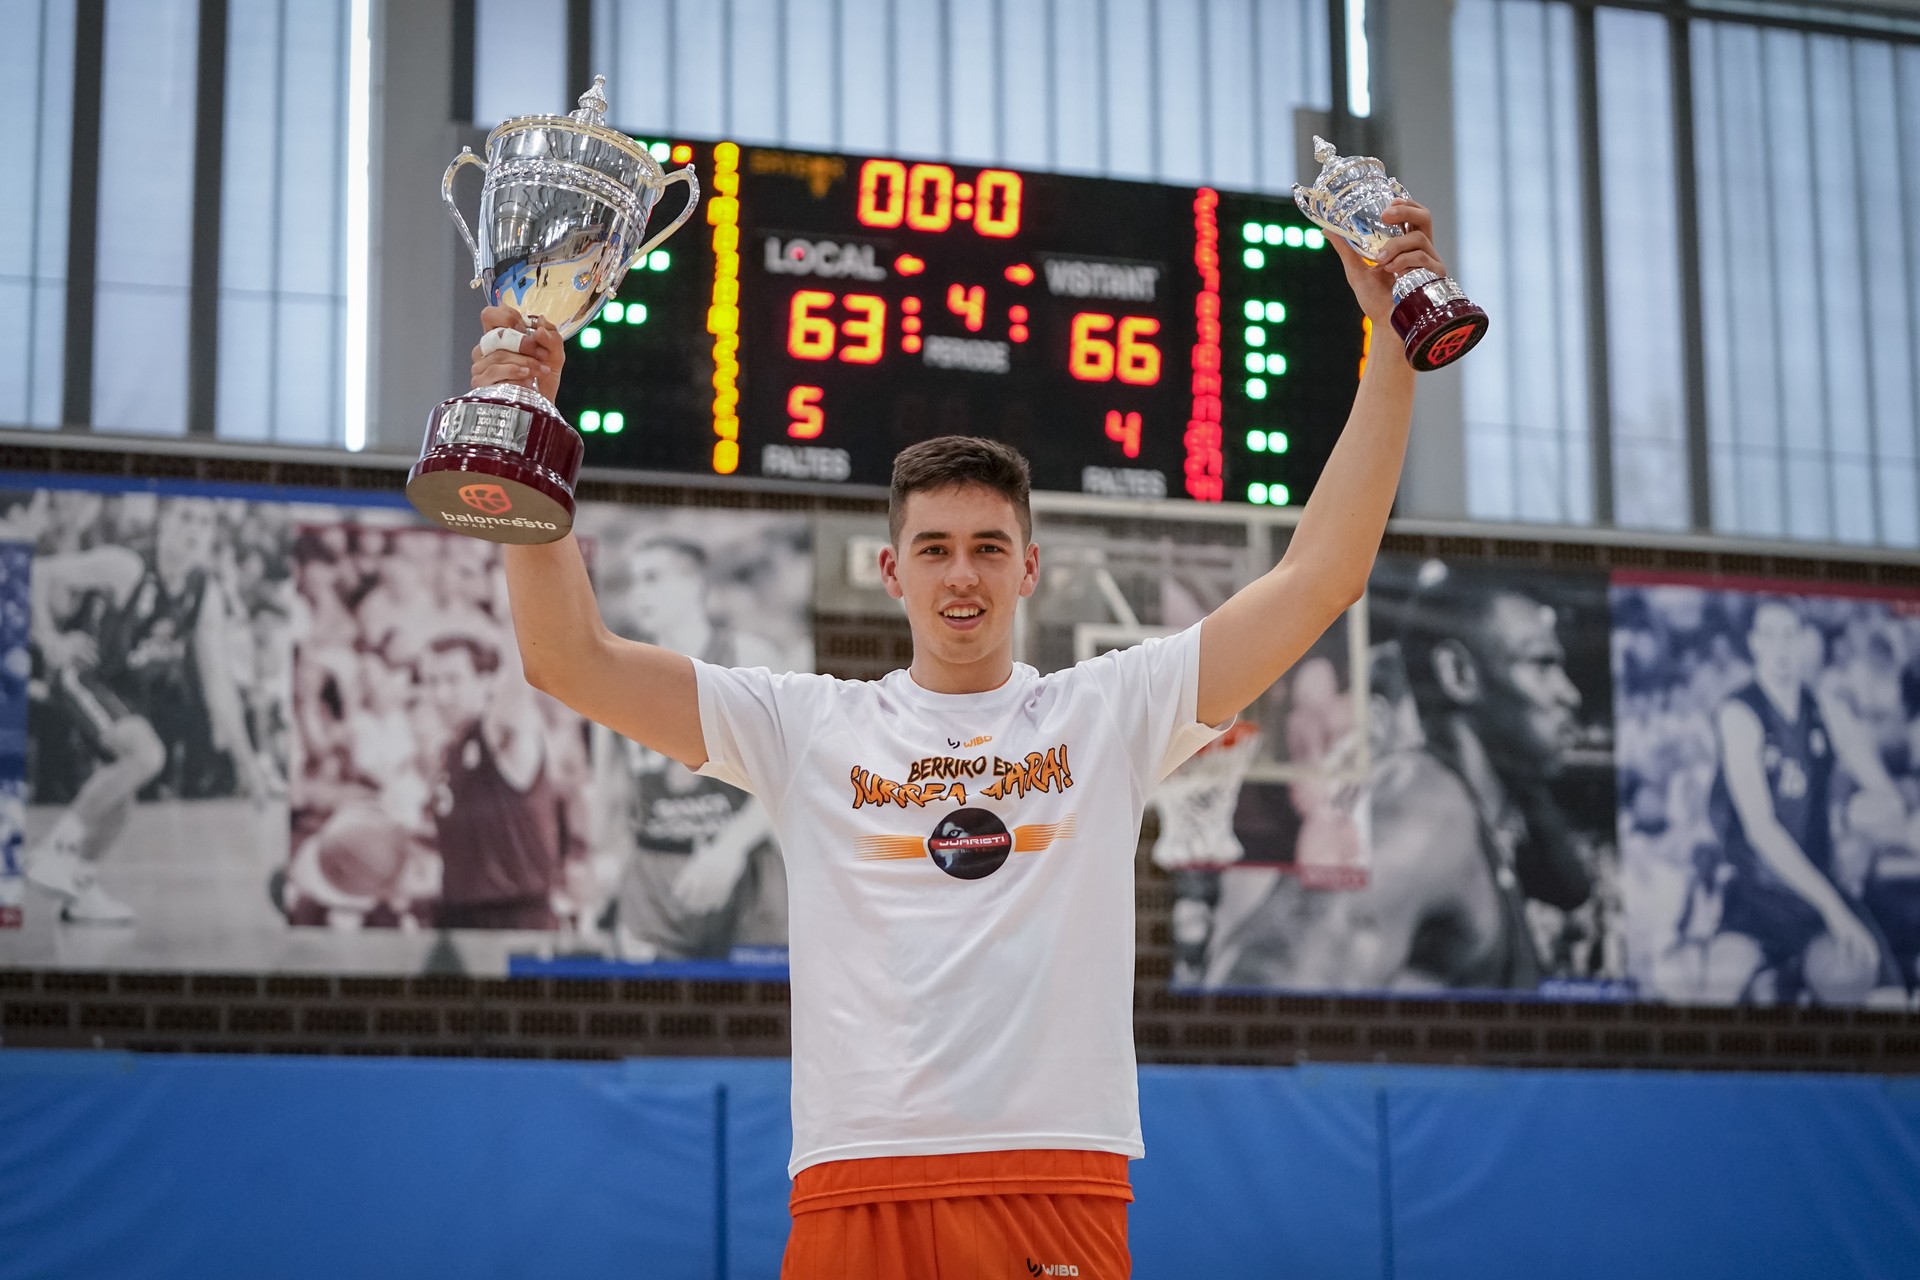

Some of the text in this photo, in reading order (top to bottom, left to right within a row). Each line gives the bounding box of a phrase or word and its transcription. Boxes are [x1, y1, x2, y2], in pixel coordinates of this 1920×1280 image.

[857, 159, 1022, 238] 00:0
[764, 237, 887, 281] LOCAL
[787, 290, 886, 364] 63
[947, 284, 985, 331] 4
[1069, 312, 1161, 386] 66
[1105, 410, 1142, 458] 4
[762, 444, 851, 482] FALTES
[441, 511, 557, 530] baloncesto
[447, 521, 495, 529] ESPAÑA
[963, 736, 992, 748] WIBO
[939, 836, 1005, 847] JUARISTI
[1042, 1264, 1079, 1277] WIBO
